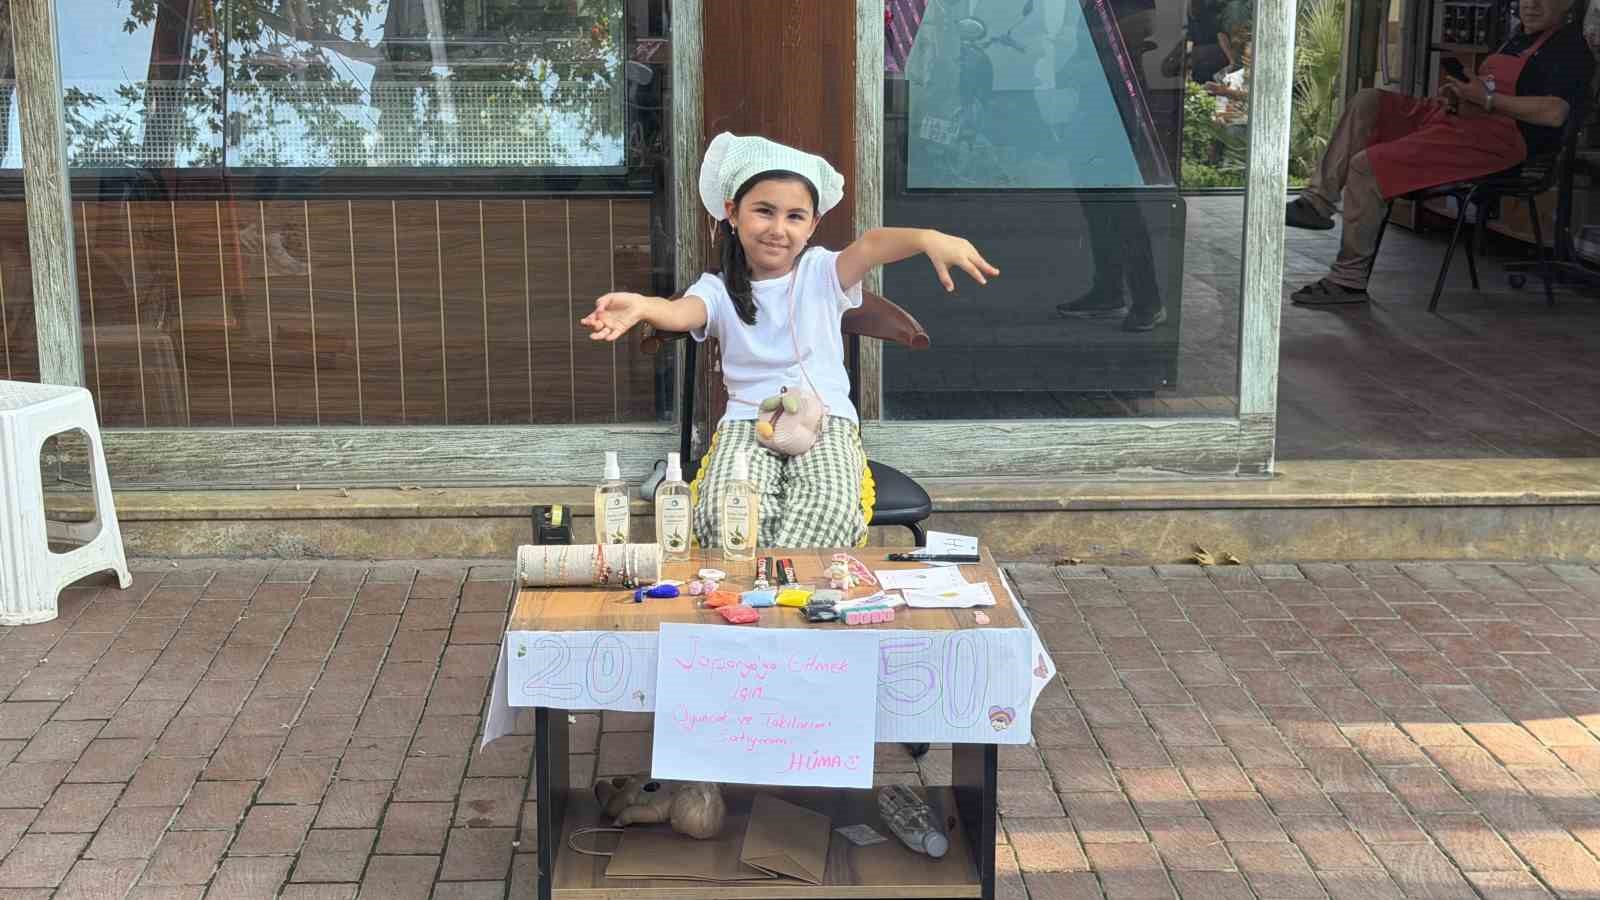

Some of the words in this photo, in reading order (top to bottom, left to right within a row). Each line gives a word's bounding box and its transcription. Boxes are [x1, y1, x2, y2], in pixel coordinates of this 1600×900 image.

[522, 632, 632, 704] 20
[878, 631, 990, 728] 50
[737, 713, 753, 726] ve
